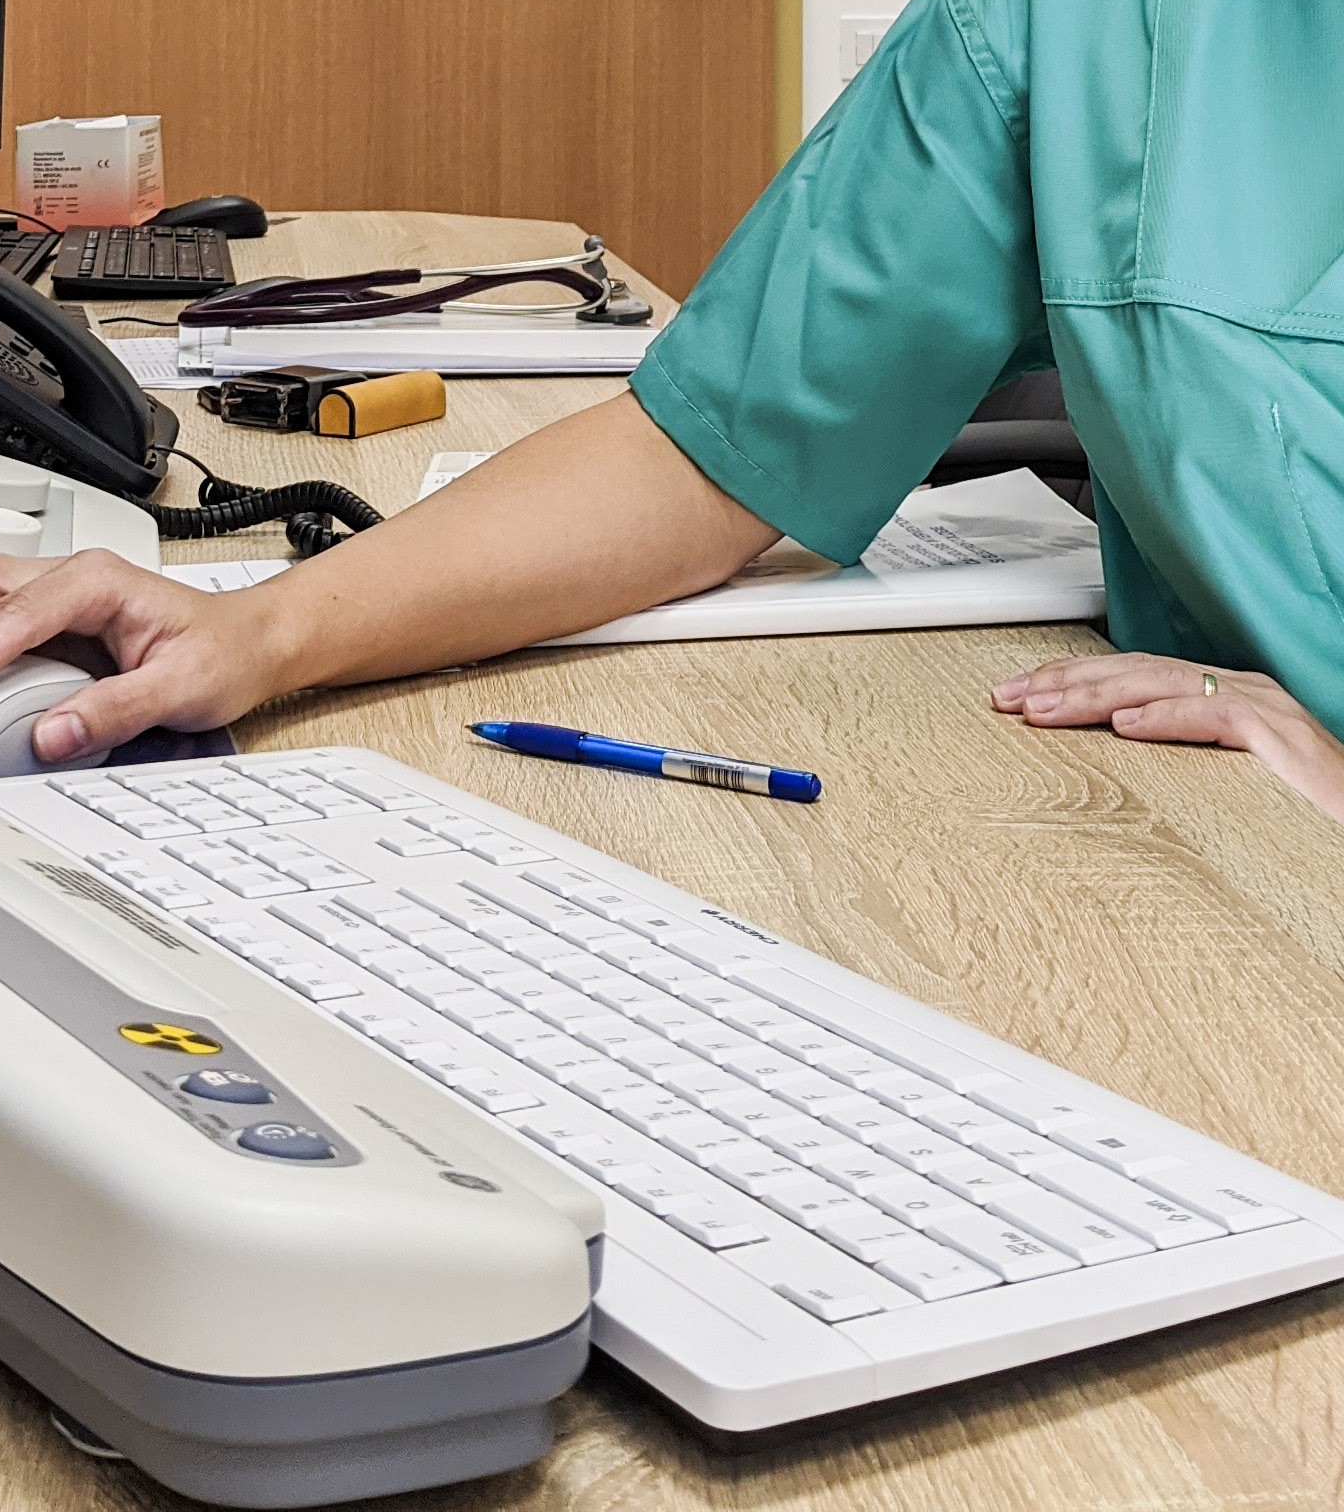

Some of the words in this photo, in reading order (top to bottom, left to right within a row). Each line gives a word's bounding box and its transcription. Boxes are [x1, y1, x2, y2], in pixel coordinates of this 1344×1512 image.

[318, 905, 352, 922] backspace
[712, 915, 780, 945] CHERRY
[644, 1112, 668, 1120] %
[597, 1159, 620, 1167] F3
[845, 1170, 874, 1179] W
[647, 1189, 672, 1197] F2
[1216, 1189, 1262, 1207] control
[905, 1201, 929, 1209] Q
[1146, 1200, 1176, 1212] shift
[1084, 1225, 1115, 1238] caps
[1001, 1232, 1024, 1242] tab
